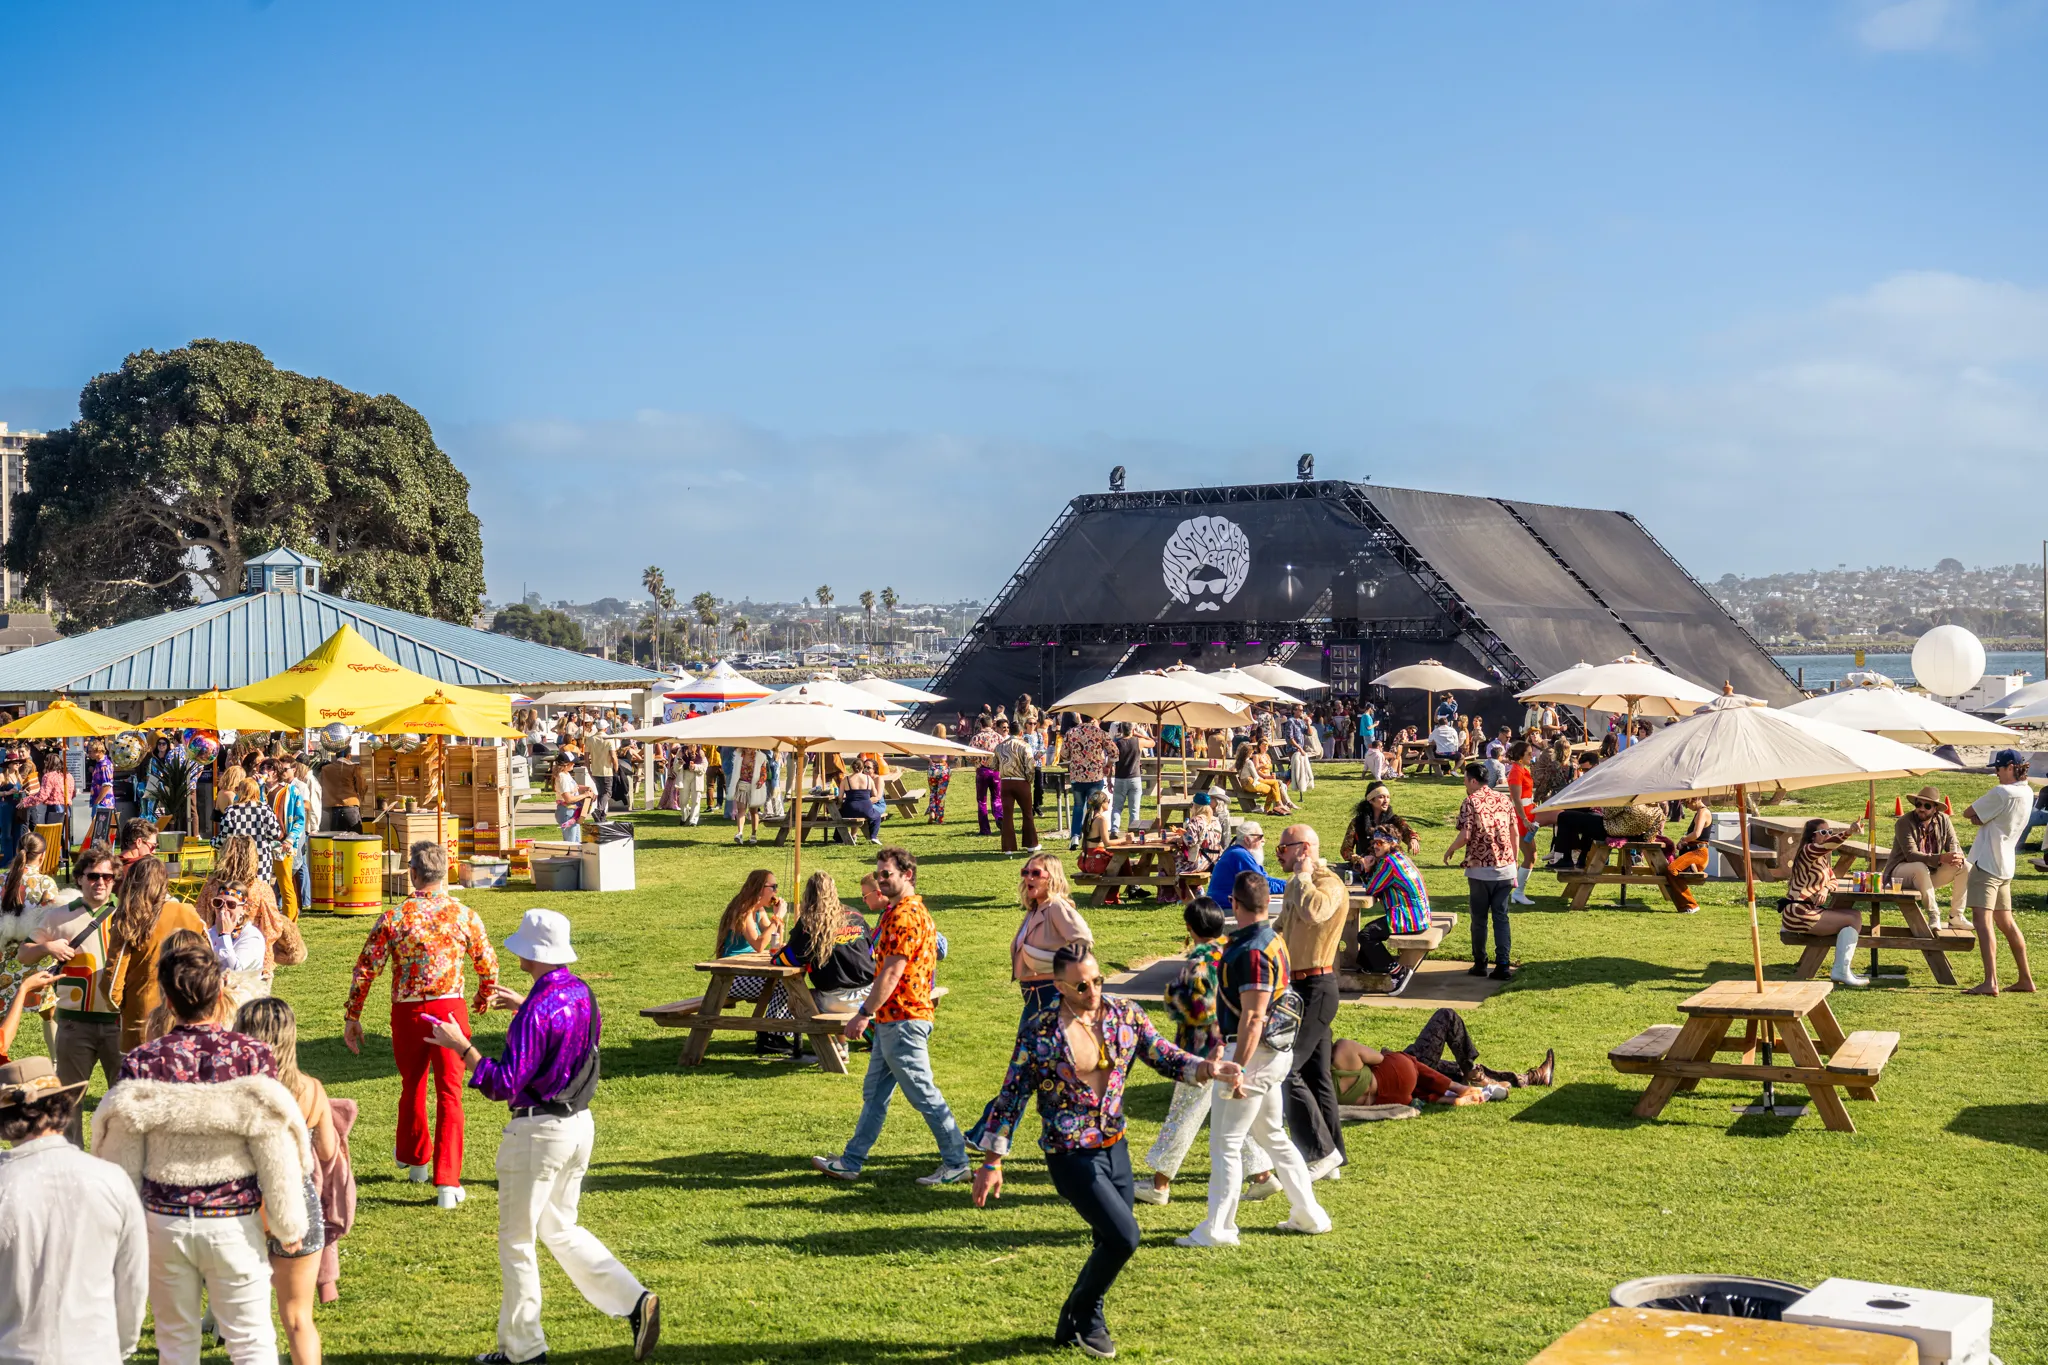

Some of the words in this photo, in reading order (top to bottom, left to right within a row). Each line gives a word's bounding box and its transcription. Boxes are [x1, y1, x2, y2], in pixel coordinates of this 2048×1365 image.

[1162, 515, 1250, 605] MUSTACHE
[347, 663, 375, 672] Topo
[374, 663, 399, 673] Chico
[319, 708, 338, 719] Topo
[337, 707, 356, 719] Chico
[357, 851, 373, 861] Topo
[353, 876, 378, 884] EVERY
